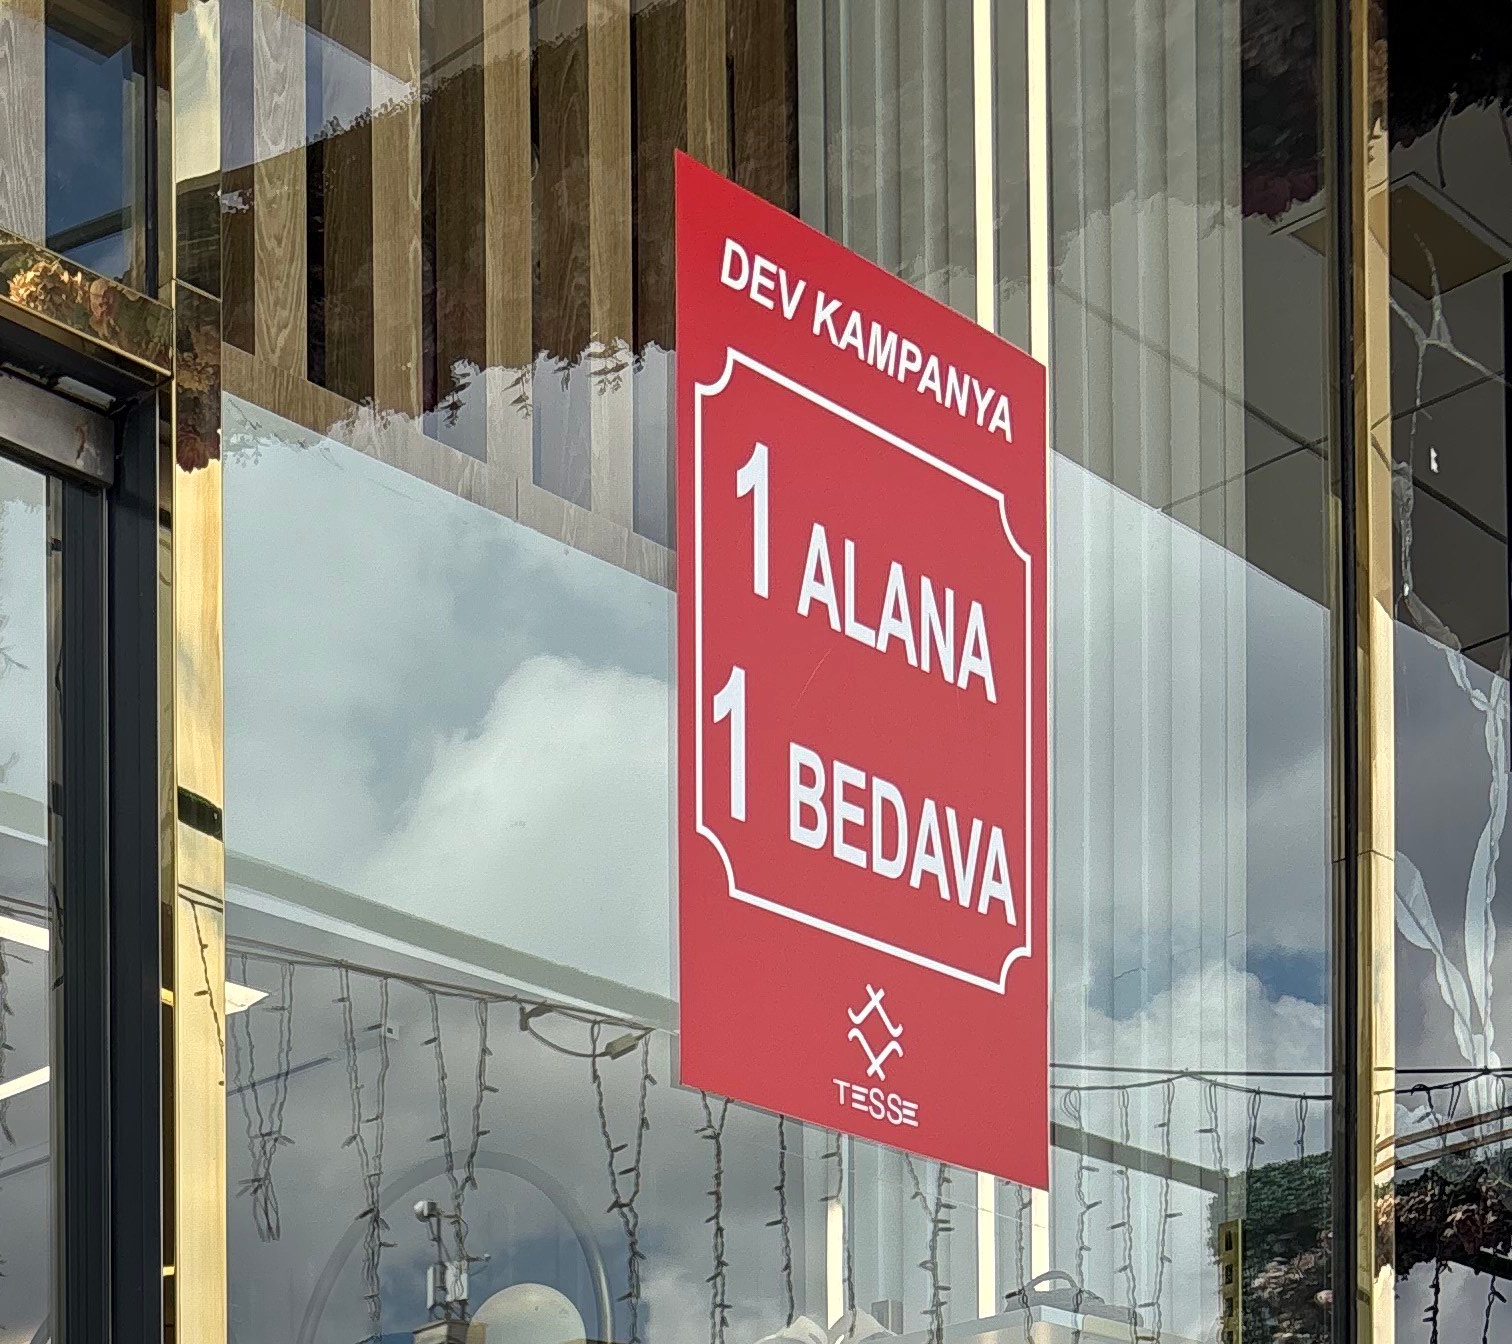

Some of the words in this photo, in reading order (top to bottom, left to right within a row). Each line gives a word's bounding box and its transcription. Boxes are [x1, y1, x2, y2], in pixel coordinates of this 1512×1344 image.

[720, 237, 807, 321] DEV
[812, 290, 1014, 443] KAMPANYA
[736, 440, 769, 600] 1
[797, 521, 998, 705] ALANA
[713, 664, 747, 823] 1
[789, 741, 1018, 927] BEDAVA
[832, 1077, 920, 1128] TESSE
